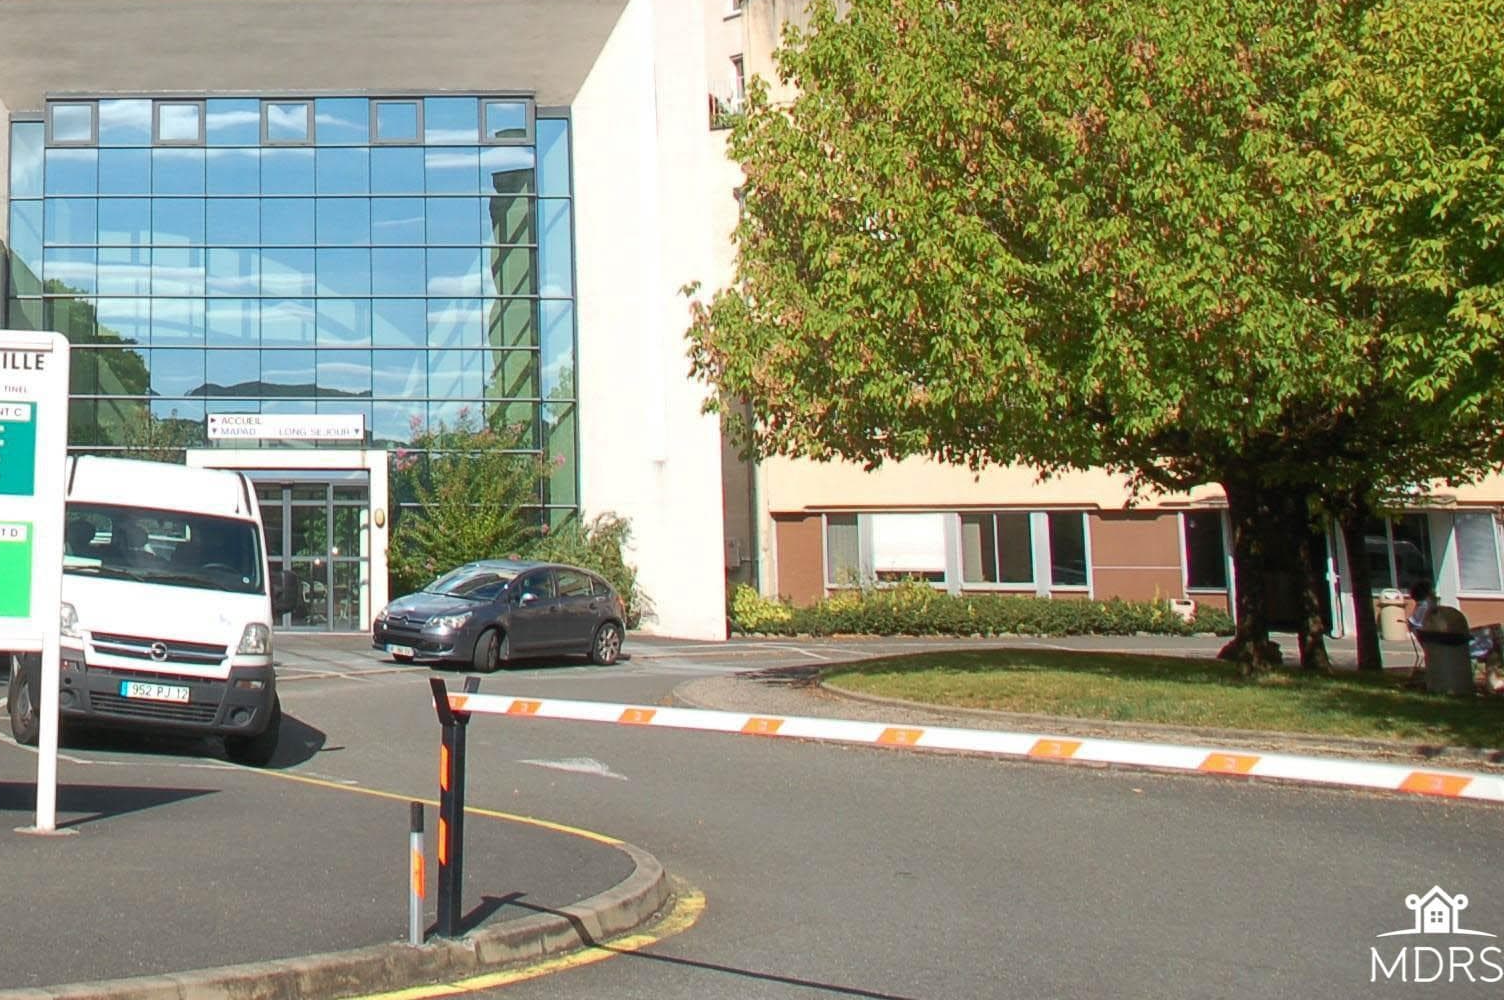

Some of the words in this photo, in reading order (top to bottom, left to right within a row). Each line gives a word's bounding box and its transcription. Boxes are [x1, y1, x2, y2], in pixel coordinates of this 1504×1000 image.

[14, 407, 22, 417] C
[221, 416, 263, 425] ACCUEIL
[10, 528, 19, 538] D
[132, 684, 152, 697] 952
[156, 686, 171, 698] PJ
[176, 687, 188, 699] 12
